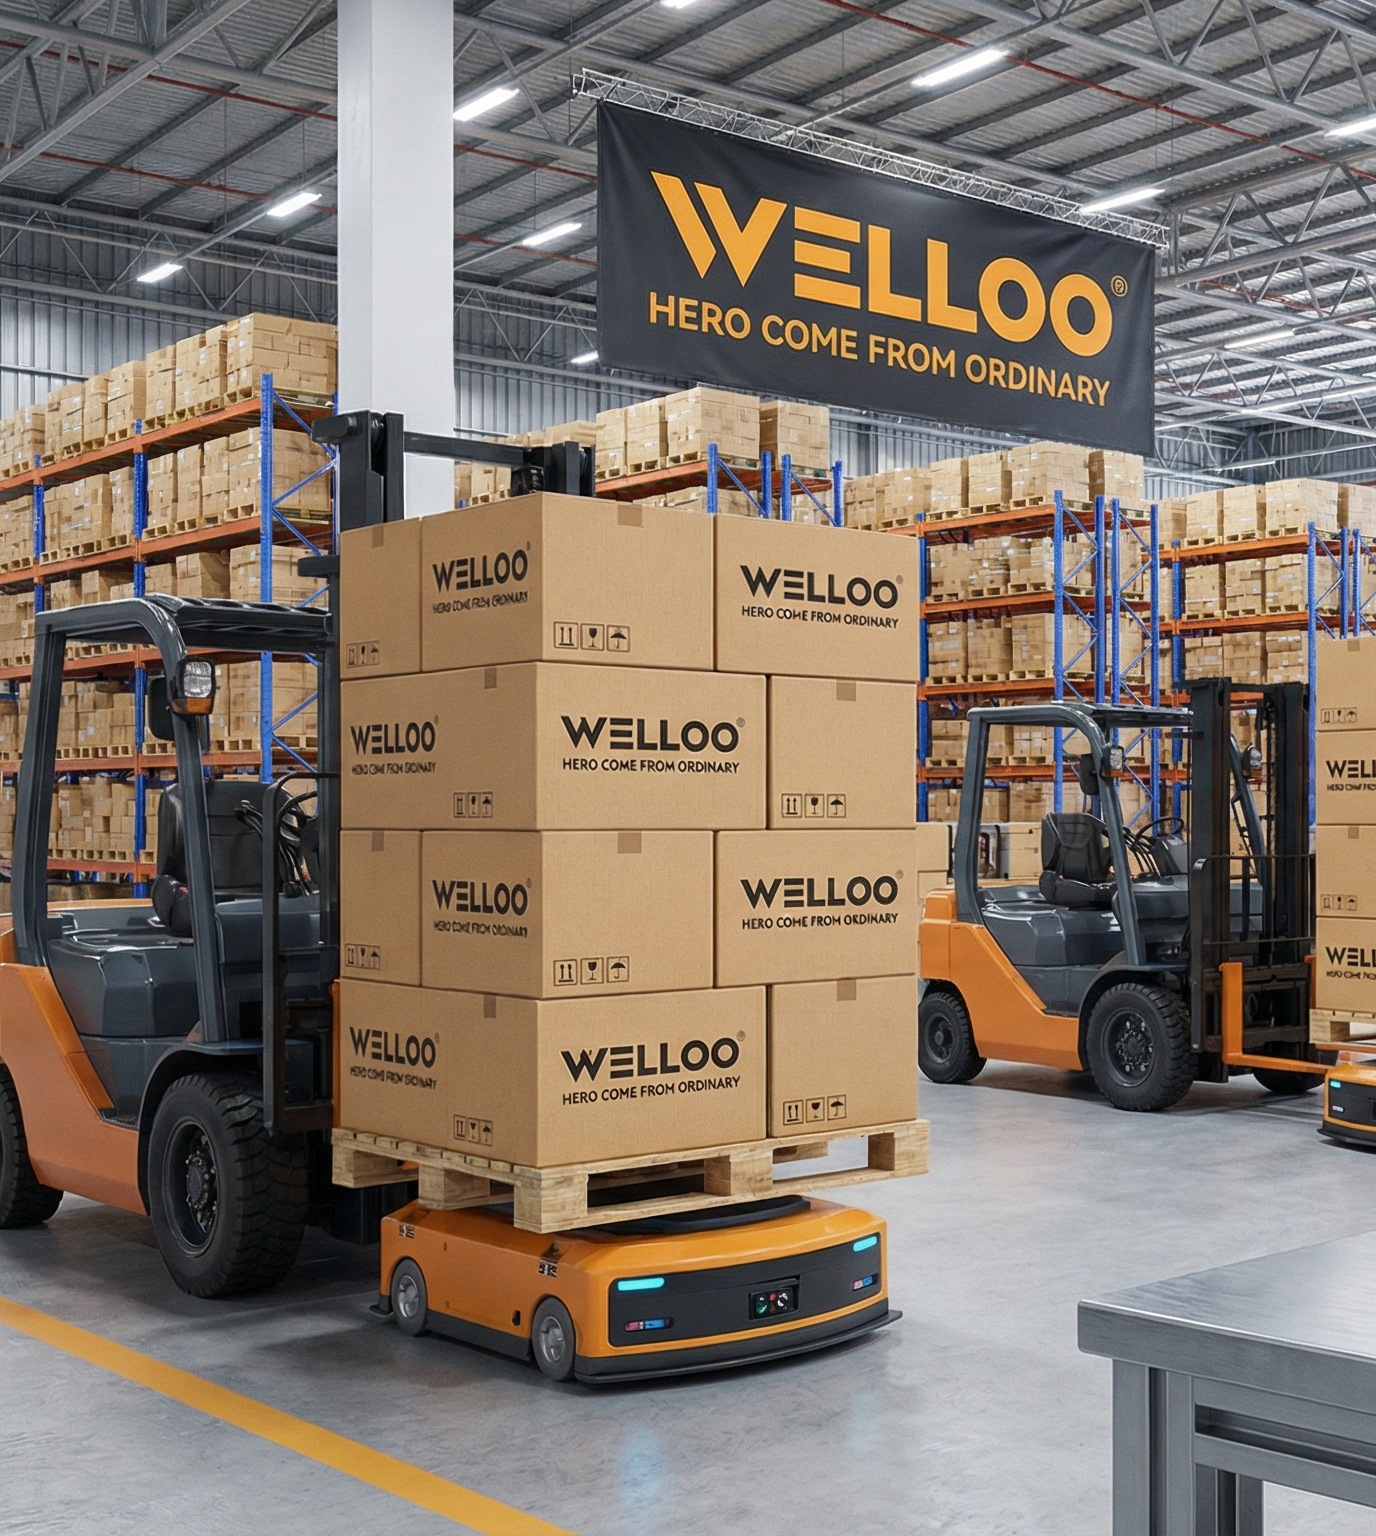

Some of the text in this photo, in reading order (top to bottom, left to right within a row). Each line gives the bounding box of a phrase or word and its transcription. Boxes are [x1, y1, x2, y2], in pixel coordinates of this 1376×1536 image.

[651, 171, 1112, 356] WELLOO
[649, 291, 1111, 406] HERO COME FROM ORDINARY
[432, 549, 528, 593] WELLOO
[740, 565, 898, 609] WELLOO
[742, 605, 773, 618] HERO
[811, 611, 841, 623] FROM
[843, 614, 899, 629] ORDINARY
[350, 721, 436, 755] WELLOO
[561, 716, 739, 752] WELLOO
[563, 758, 740, 774] HERO COME FROM ORDINARY
[432, 880, 528, 916] WELLOO
[740, 875, 898, 909] WELLOO
[742, 918, 773, 929] HERO
[776, 916, 808, 928] COME
[811, 915, 841, 927] FROM
[349, 1026, 436, 1068] WELLOO
[561, 1037, 740, 1083] WELLOO
[562, 1076, 741, 1105] HERO COME FROM ORDINARY
